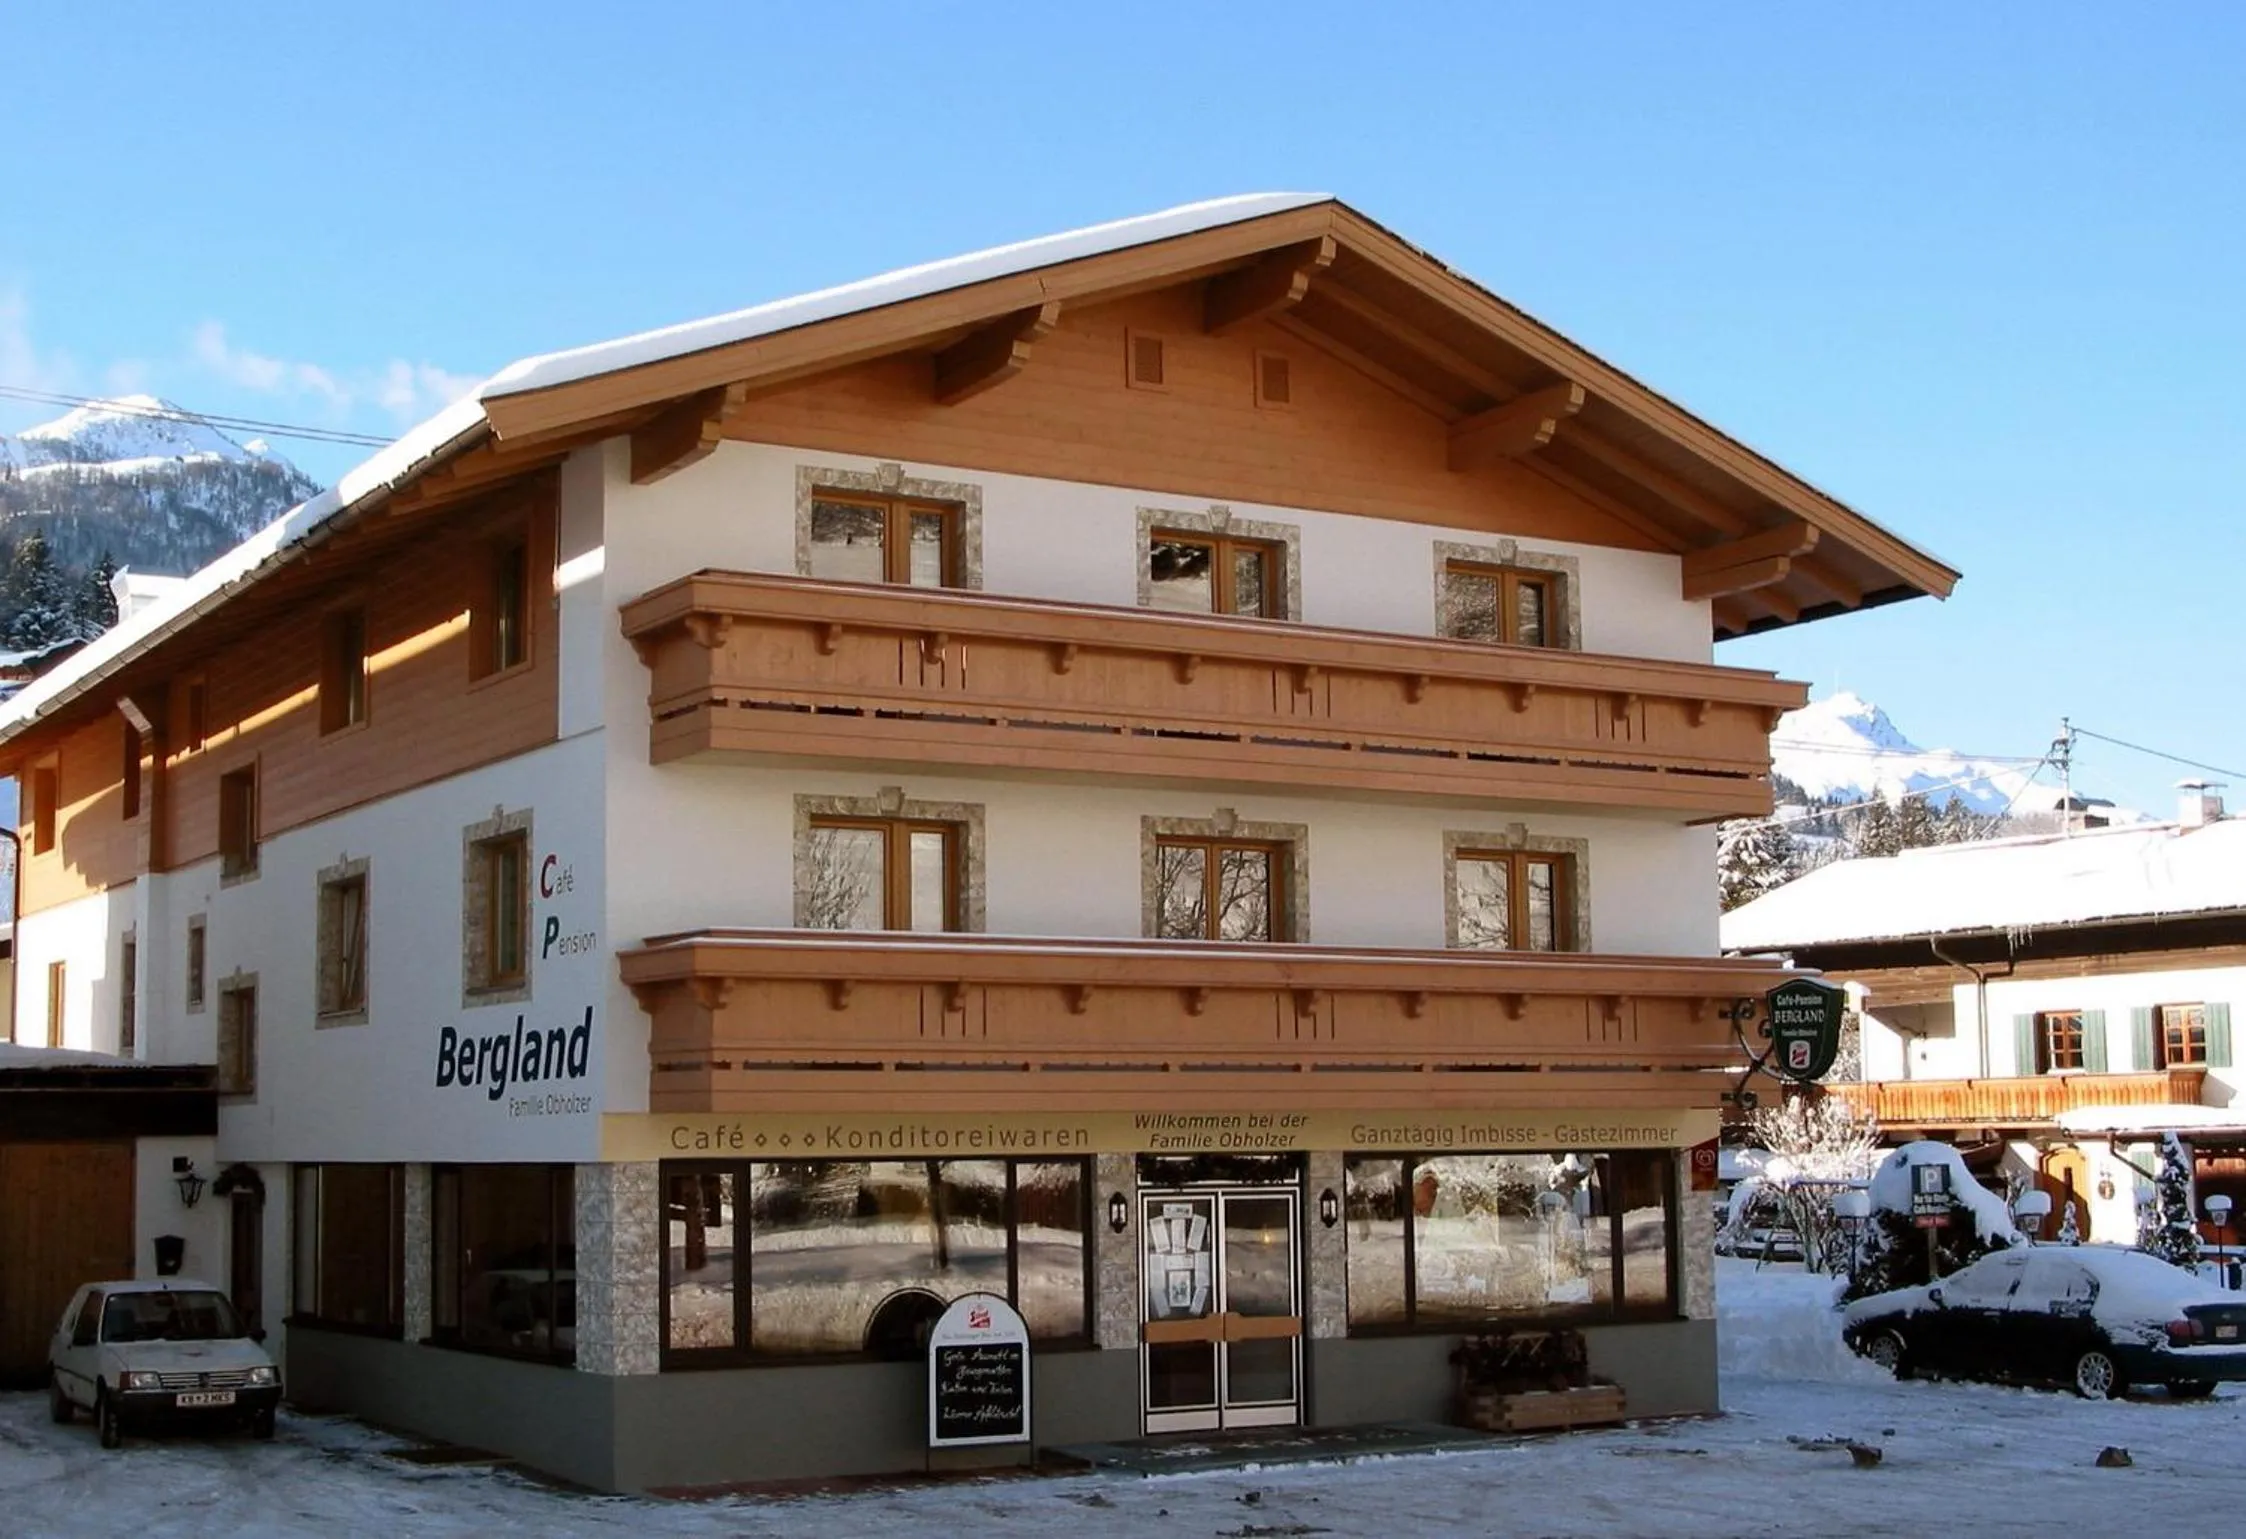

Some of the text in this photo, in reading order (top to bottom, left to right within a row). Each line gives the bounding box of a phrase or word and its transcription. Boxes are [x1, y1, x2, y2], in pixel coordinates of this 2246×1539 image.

[540, 854, 574, 899] Café
[542, 915, 597, 960] Pension
[436, 1005, 593, 1101] Bergland
[1135, 1111, 1309, 1129] Willkommen bei der
[670, 1123, 1090, 1150] Café Konditoreiwaren
[1149, 1131, 1296, 1149] Familie Obholzer
[1351, 1124, 1453, 1147] Ganztägig
[1460, 1124, 1536, 1143] Imbisse
[1554, 1122, 1678, 1143] Gästezimmer
[1924, 1168, 1938, 1192] P
